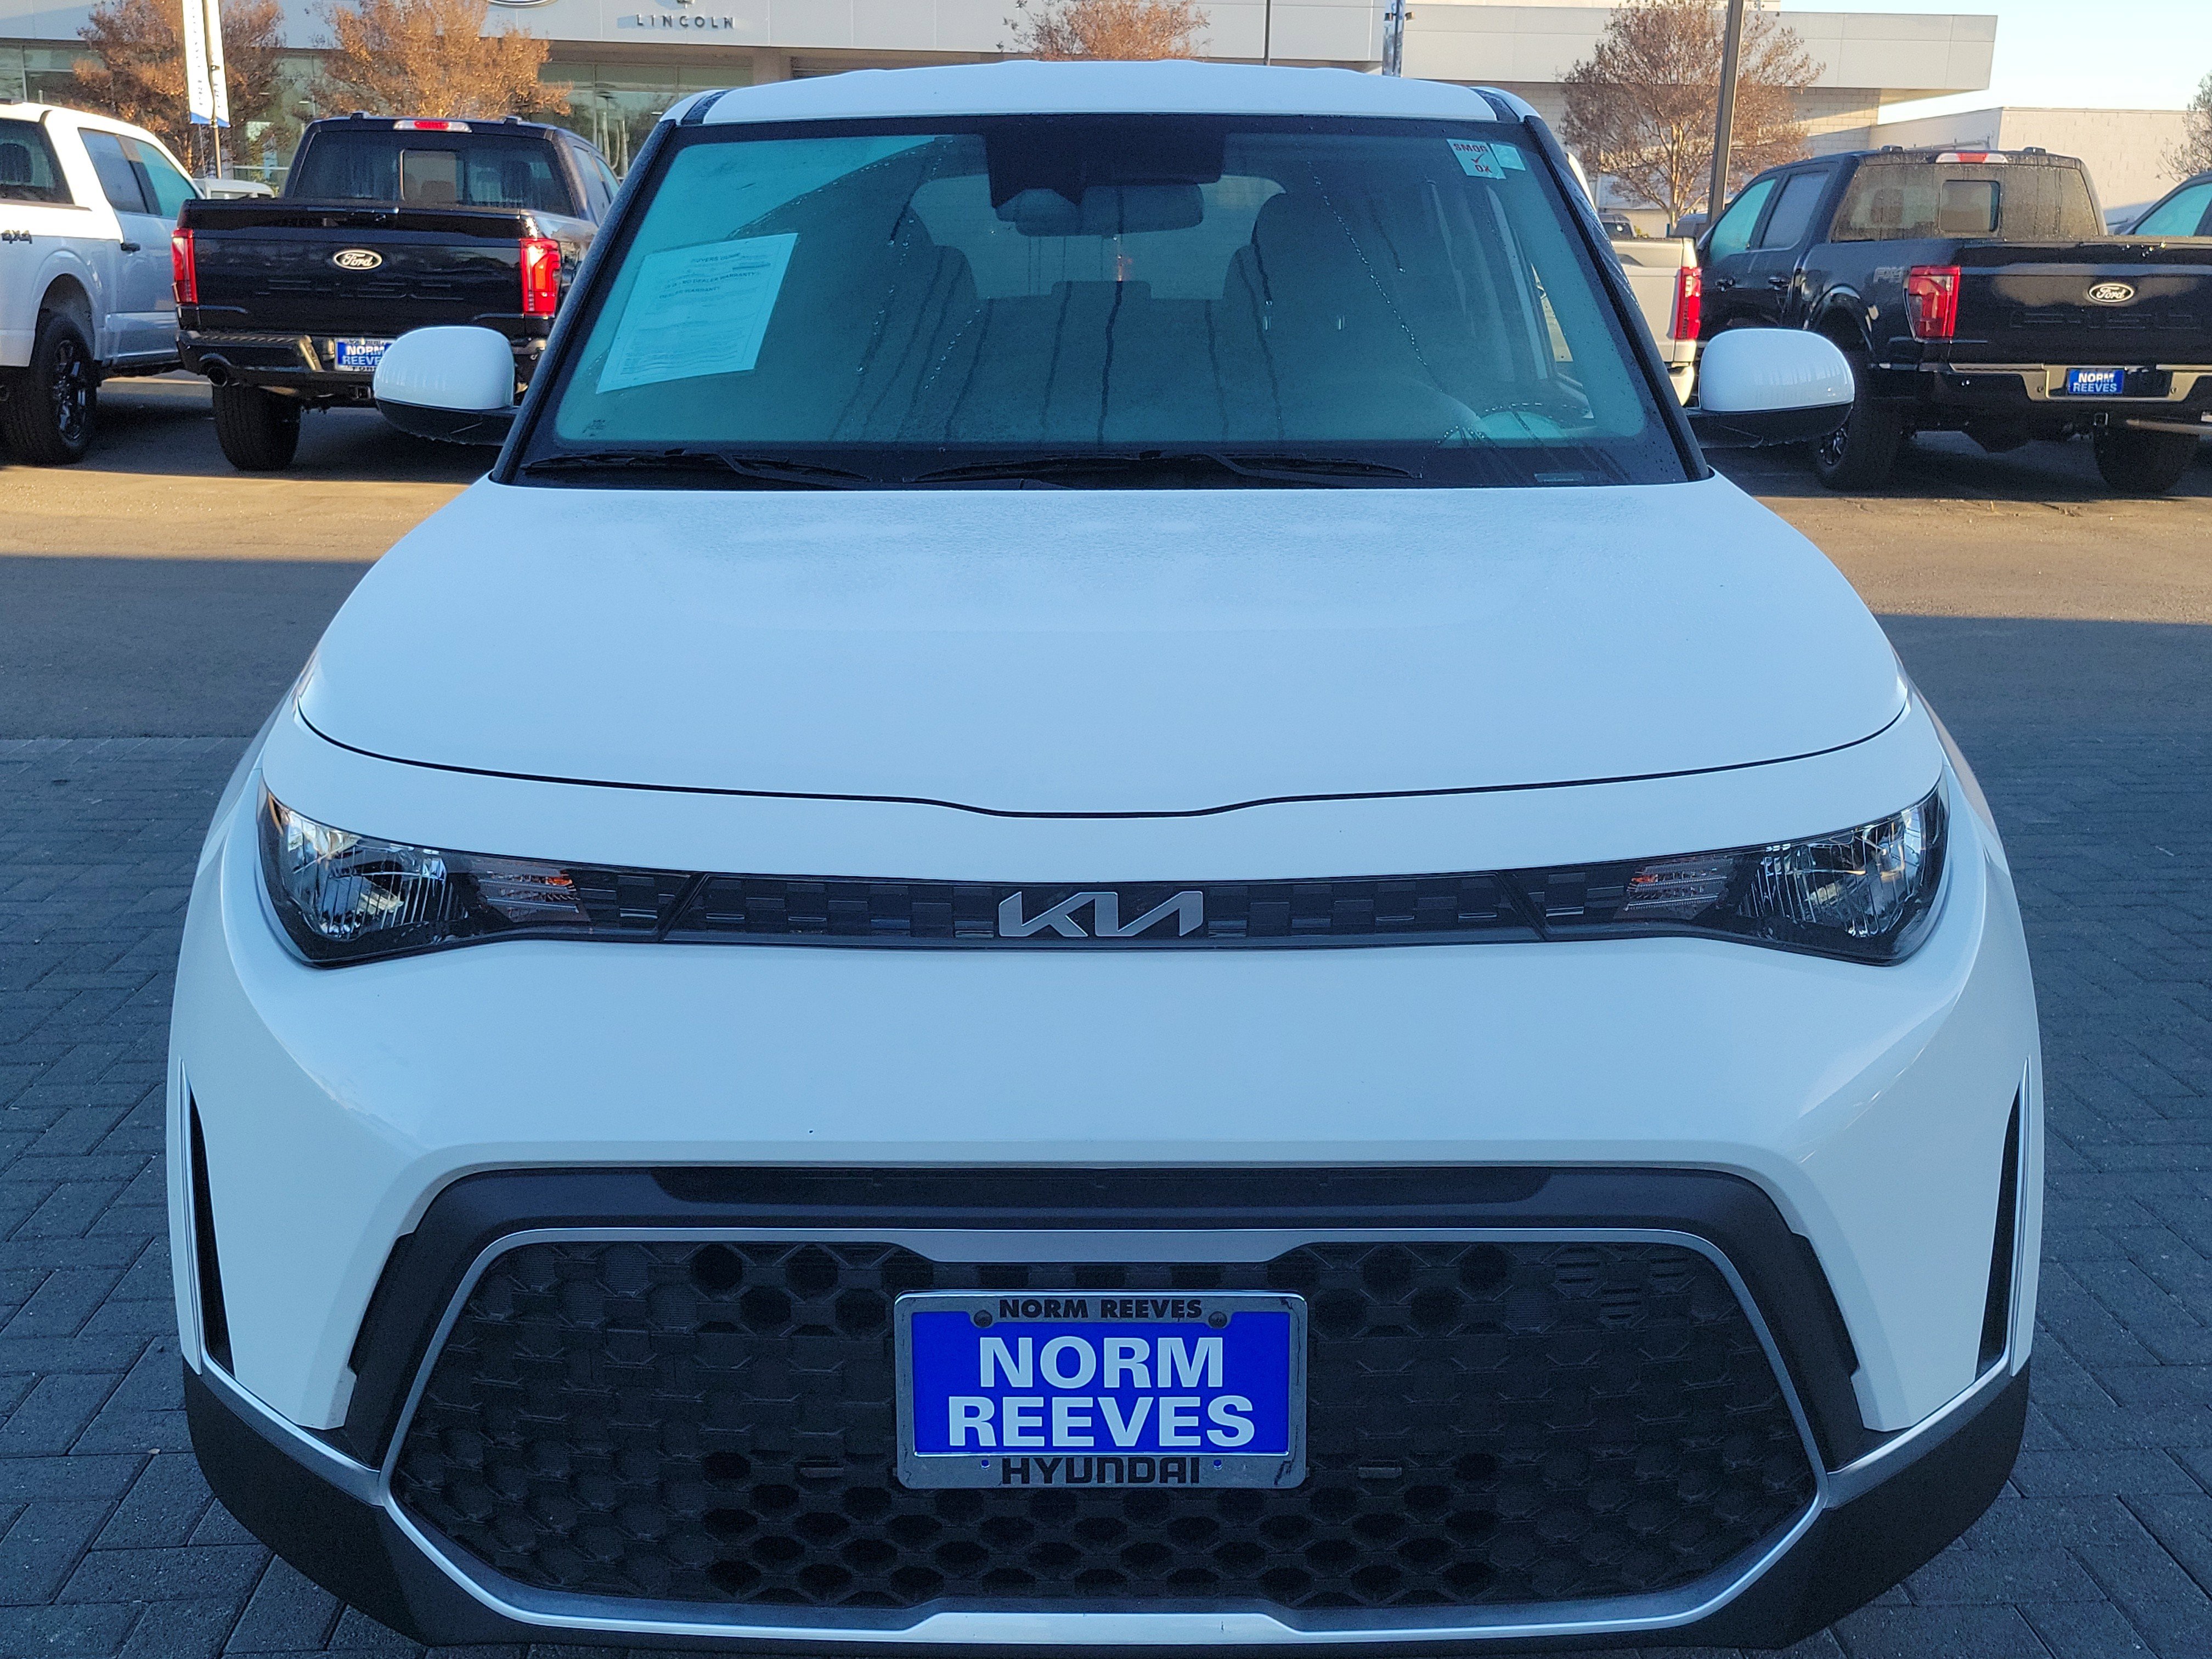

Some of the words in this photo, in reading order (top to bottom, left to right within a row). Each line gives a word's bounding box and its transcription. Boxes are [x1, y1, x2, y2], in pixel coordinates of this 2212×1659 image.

[636, 14, 734, 29] LINCOLN
[342, 253, 374, 267] Ford
[2096, 286, 2126, 299] Ford
[346, 346, 385, 356] NORM
[342, 356, 382, 365] REEVE
[2078, 373, 2114, 382] NORM
[2073, 382, 2117, 392] REEVES
[998, 891, 1204, 937] KIA
[999, 1299, 1088, 1318] NORM
[1101, 1299, 1202, 1318] REEVES
[979, 1336, 1223, 1389] NORM
[948, 1395, 1255, 1448] REEVES
[1002, 1457, 1200, 1485] HYUNDAI
